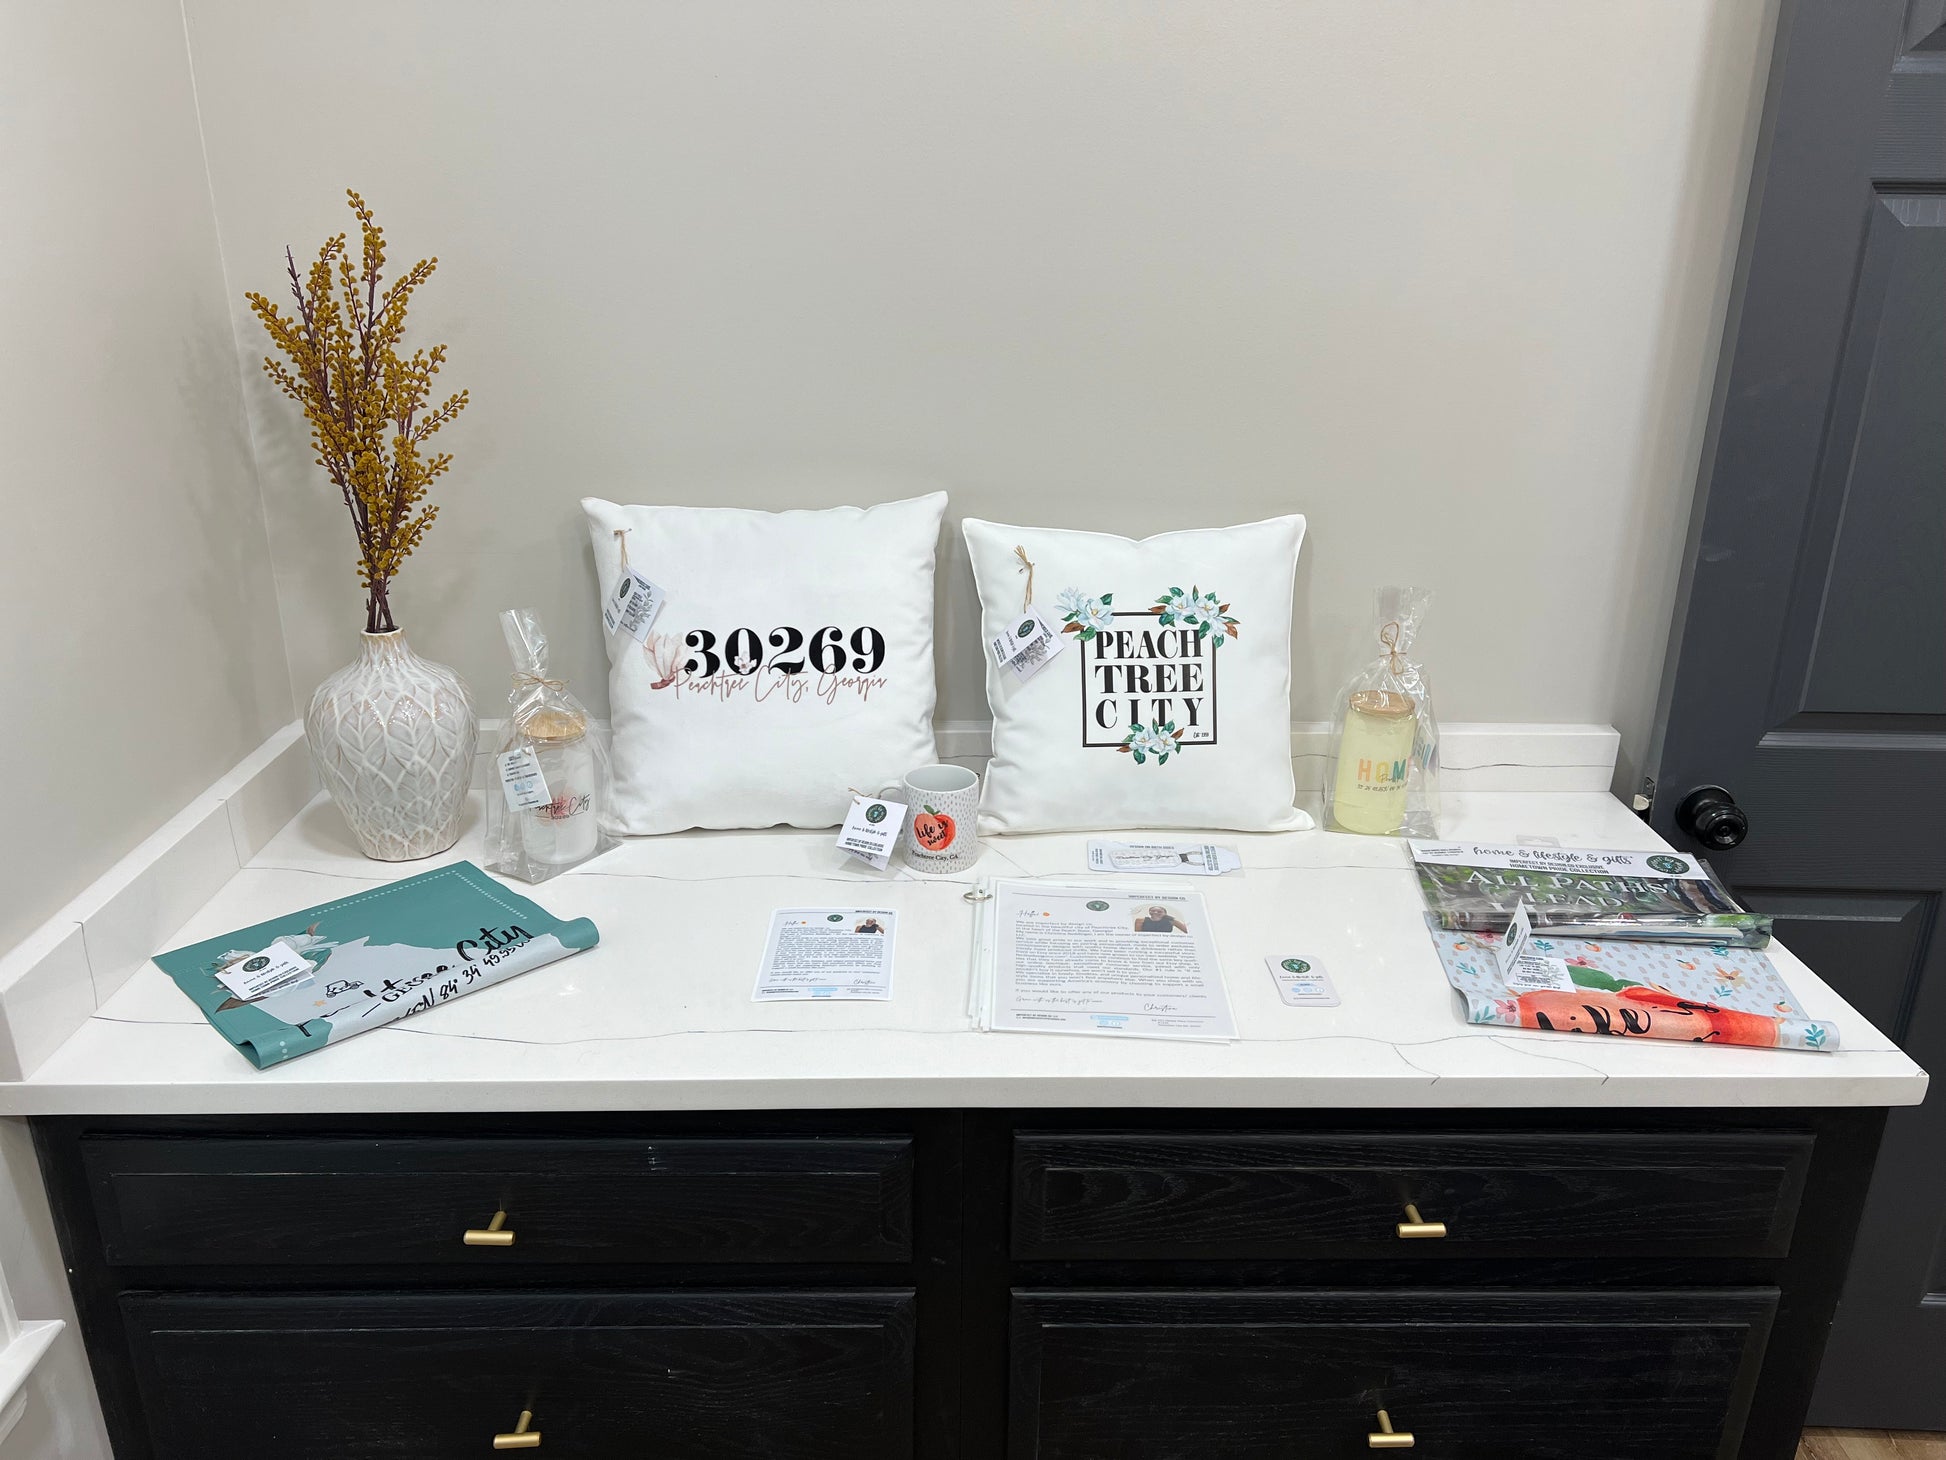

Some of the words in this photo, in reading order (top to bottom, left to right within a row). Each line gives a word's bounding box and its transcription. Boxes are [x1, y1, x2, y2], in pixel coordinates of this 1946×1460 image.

[685, 625, 886, 679] 30269
[1094, 628, 1205, 661] PEACH
[674, 665, 750, 702] Peachtree
[754, 664, 810, 703] City,
[817, 664, 889, 706] Georgia
[1094, 662, 1205, 694] TREE
[1095, 697, 1205, 730] CITY
[569, 793, 592, 817] City
[914, 822, 936, 840] Life
[937, 819, 950, 830] is
[926, 829, 947, 846] sweet
[1473, 845, 1515, 858] home
[1518, 848, 1530, 859] &
[1533, 850, 1583, 864] lifestyle
[1586, 853, 1599, 863] &
[1466, 870, 1539, 887] ALL
[1547, 875, 1668, 895] PATHS
[1569, 866, 1610, 876] COLLECTION
[1524, 892, 1625, 908] LEAD
[456, 924, 535, 962] City
